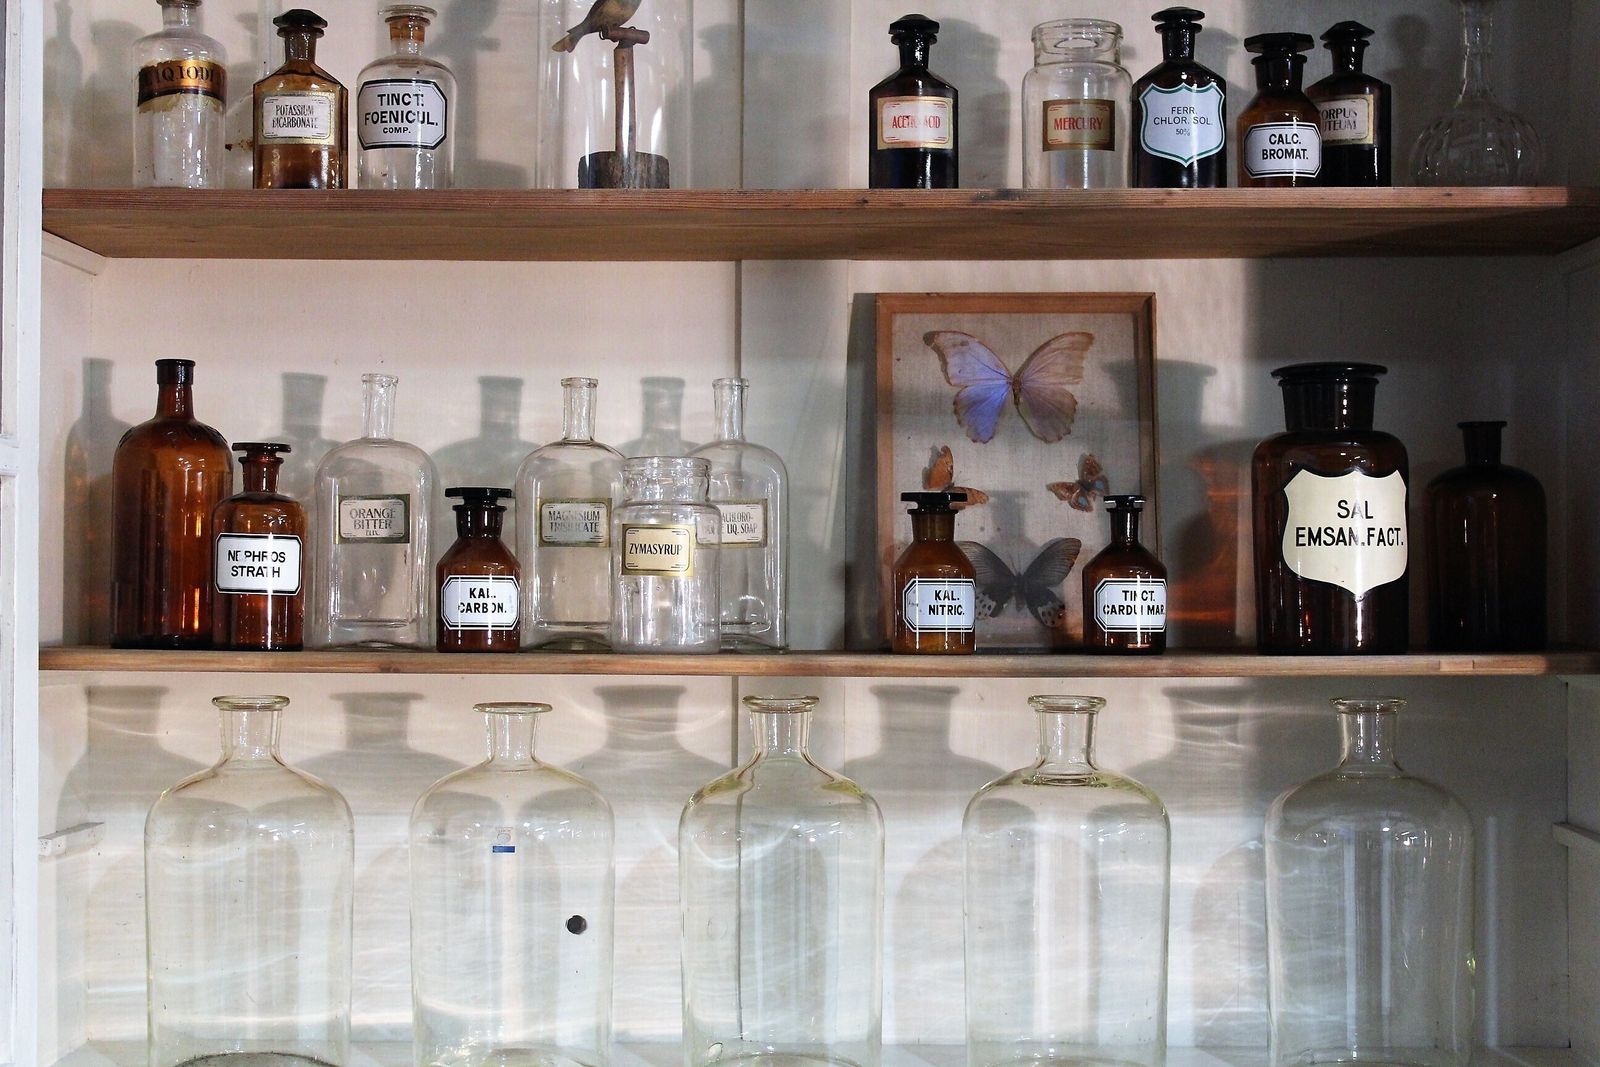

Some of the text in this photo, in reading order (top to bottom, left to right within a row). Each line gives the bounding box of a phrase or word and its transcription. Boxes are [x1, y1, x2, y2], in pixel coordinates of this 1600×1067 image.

[377, 93, 424, 107] TINCT.
[275, 105, 314, 116] POTASSIUM
[1171, 106, 1198, 115] FERR.
[1321, 108, 1358, 120] ORPUS
[272, 117, 318, 129] BICARBONATE
[364, 110, 439, 127] FOENICUL.
[1054, 117, 1104, 130] MERCURY
[1153, 116, 1190, 125] CHLOR.
[1269, 133, 1301, 145] CALC.
[1262, 148, 1308, 160] BROMAT.
[349, 508, 397, 519] ORANGE
[1337, 499, 1374, 519] SAL
[353, 519, 393, 530] BITTER
[727, 523, 740, 535] LIQ.
[740, 523, 757, 534] SOAP
[629, 543, 682, 555] ZYMASYRUP
[469, 587, 497, 599] KAL.
[934, 590, 960, 601] KAL.
[1122, 590, 1156, 602] TINCT.
[458, 602, 507, 614] CARBON.
[928, 604, 965, 616] NITRIC.
